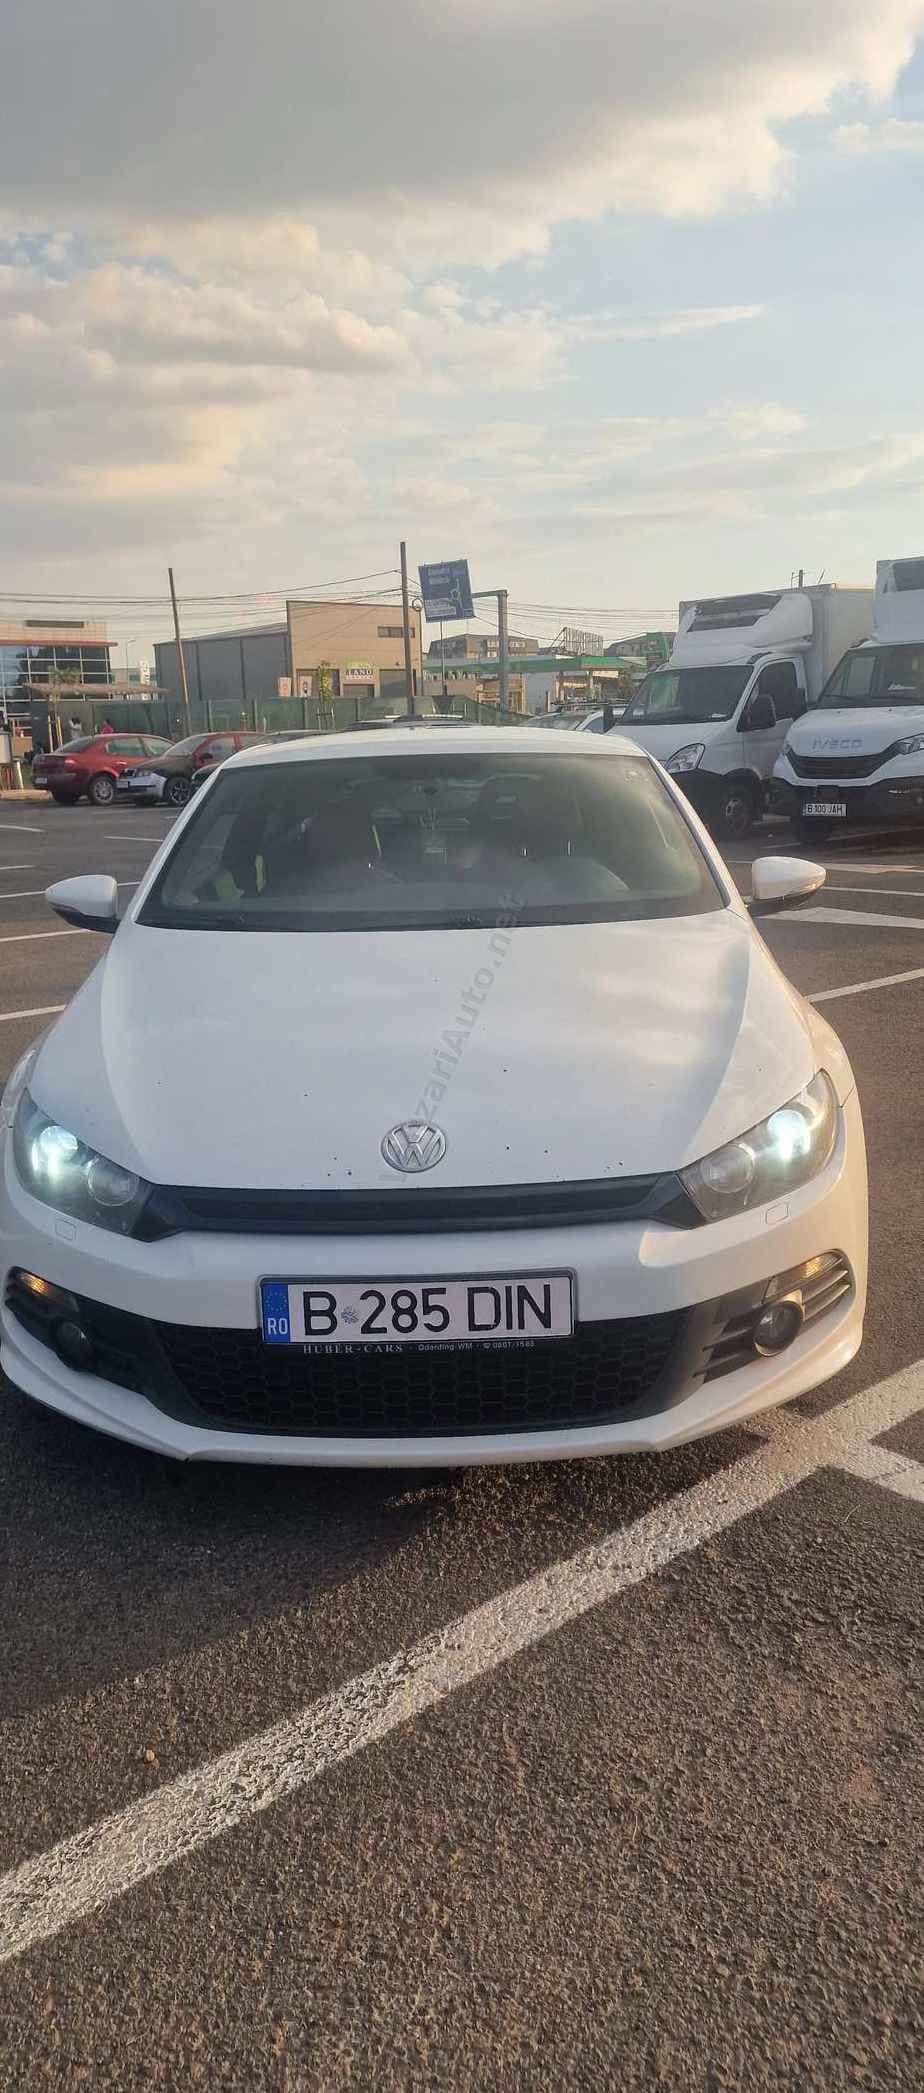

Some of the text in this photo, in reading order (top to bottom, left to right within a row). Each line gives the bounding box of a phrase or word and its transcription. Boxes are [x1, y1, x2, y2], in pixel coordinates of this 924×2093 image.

[812, 738, 863, 750] IVECO
[302, 1283, 553, 1337] B 285 DIN
[267, 1318, 288, 1336] RO
[303, 1344, 402, 1354] HUBER-CARS
